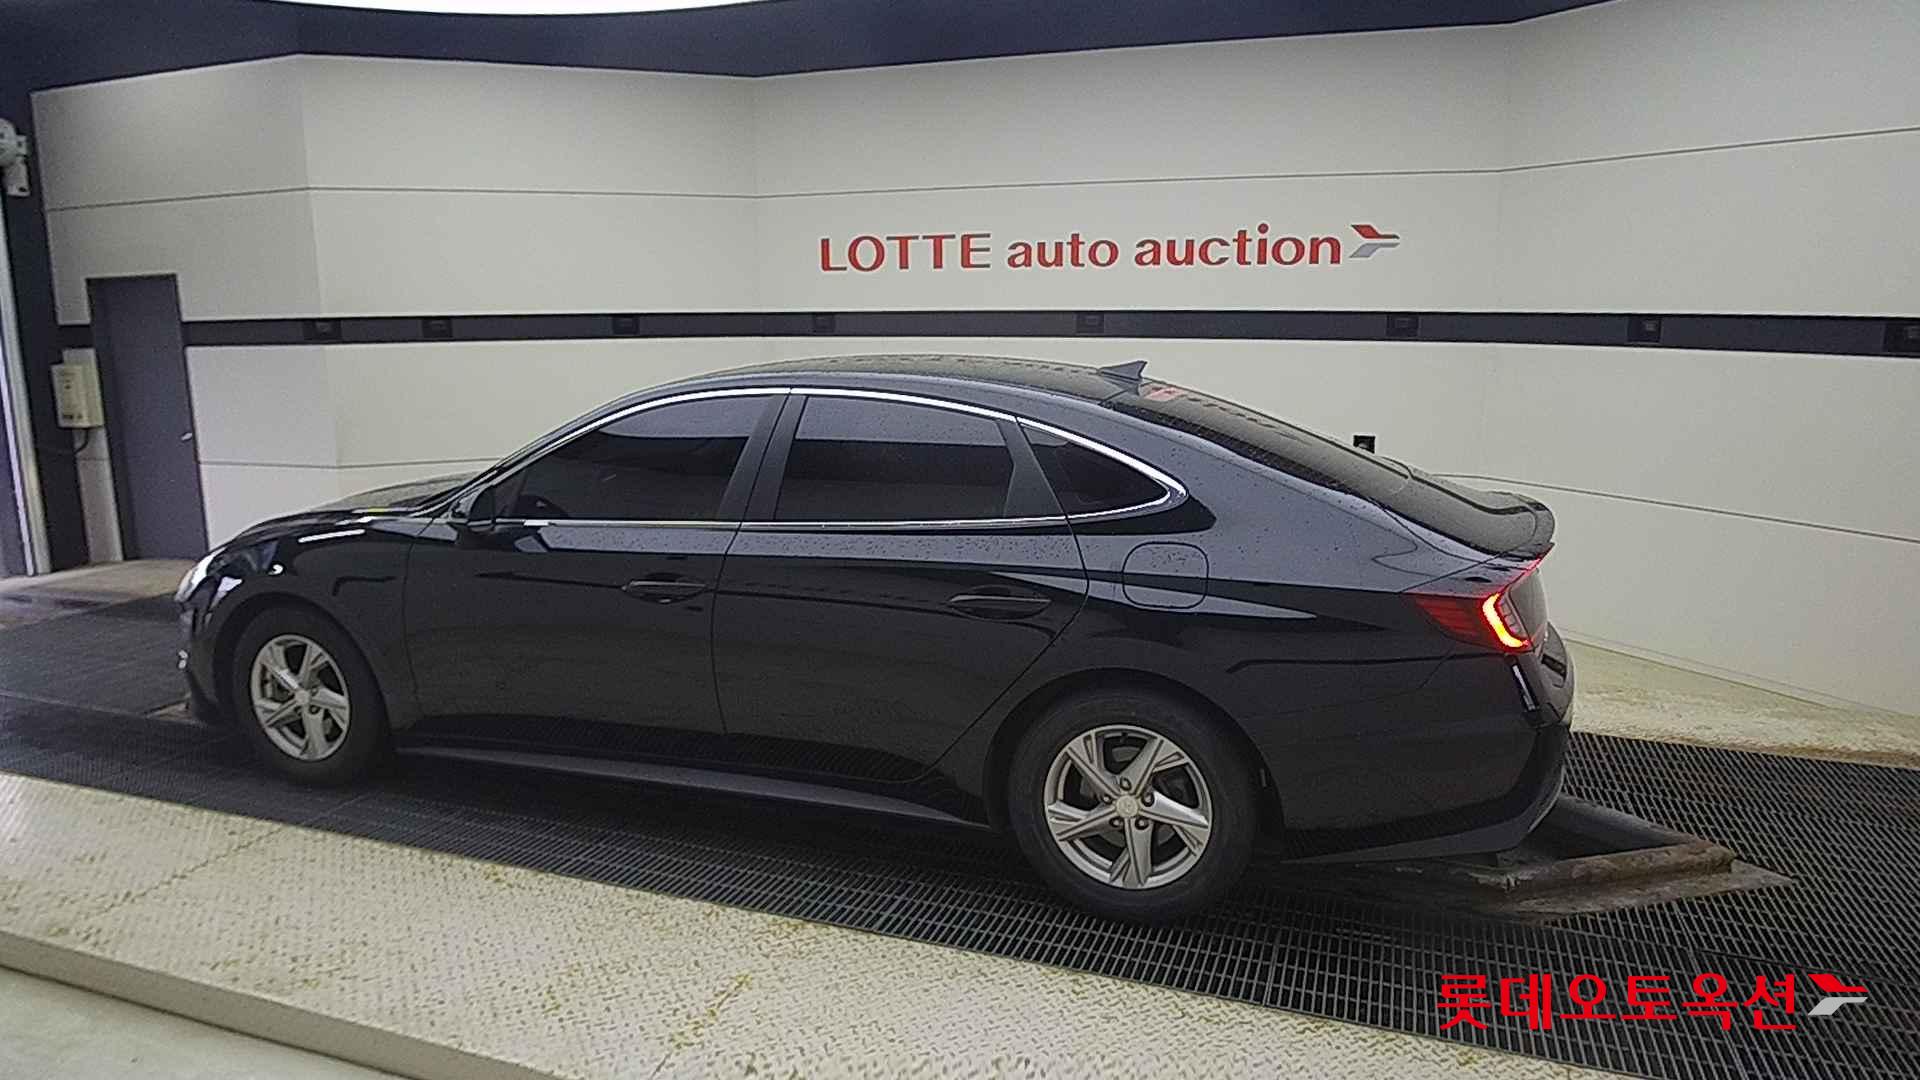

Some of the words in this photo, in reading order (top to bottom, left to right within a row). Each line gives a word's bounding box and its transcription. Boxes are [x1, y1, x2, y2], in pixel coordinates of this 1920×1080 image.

[820, 233, 991, 272] LOTTE
[1007, 234, 1119, 269] auto
[1135, 222, 1341, 267] auction
